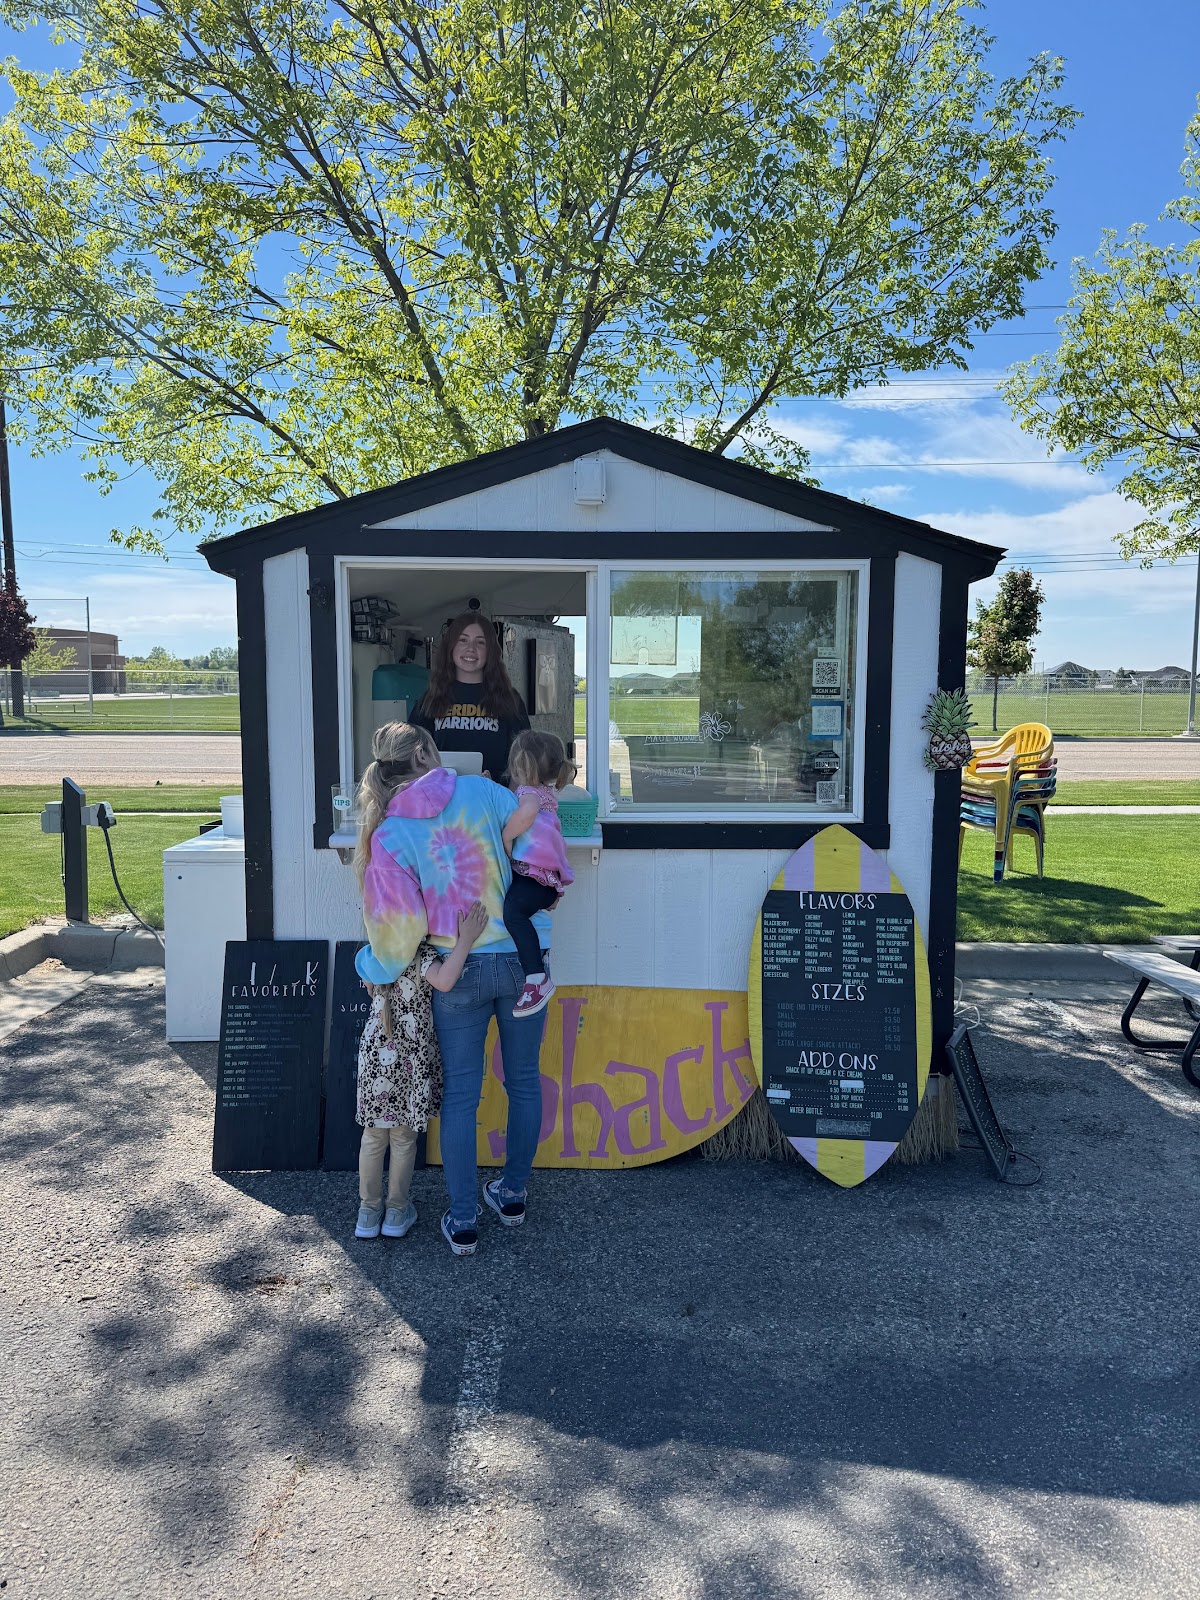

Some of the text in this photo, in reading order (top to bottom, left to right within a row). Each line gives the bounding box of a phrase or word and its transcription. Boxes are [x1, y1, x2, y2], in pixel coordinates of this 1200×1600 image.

[434, 717, 499, 732] WARRIORS
[932, 740, 970, 753] aloha
[799, 892, 877, 910] FLAVORS
[811, 983, 866, 1001] SIZES
[798, 1050, 879, 1071] ADD ONS
